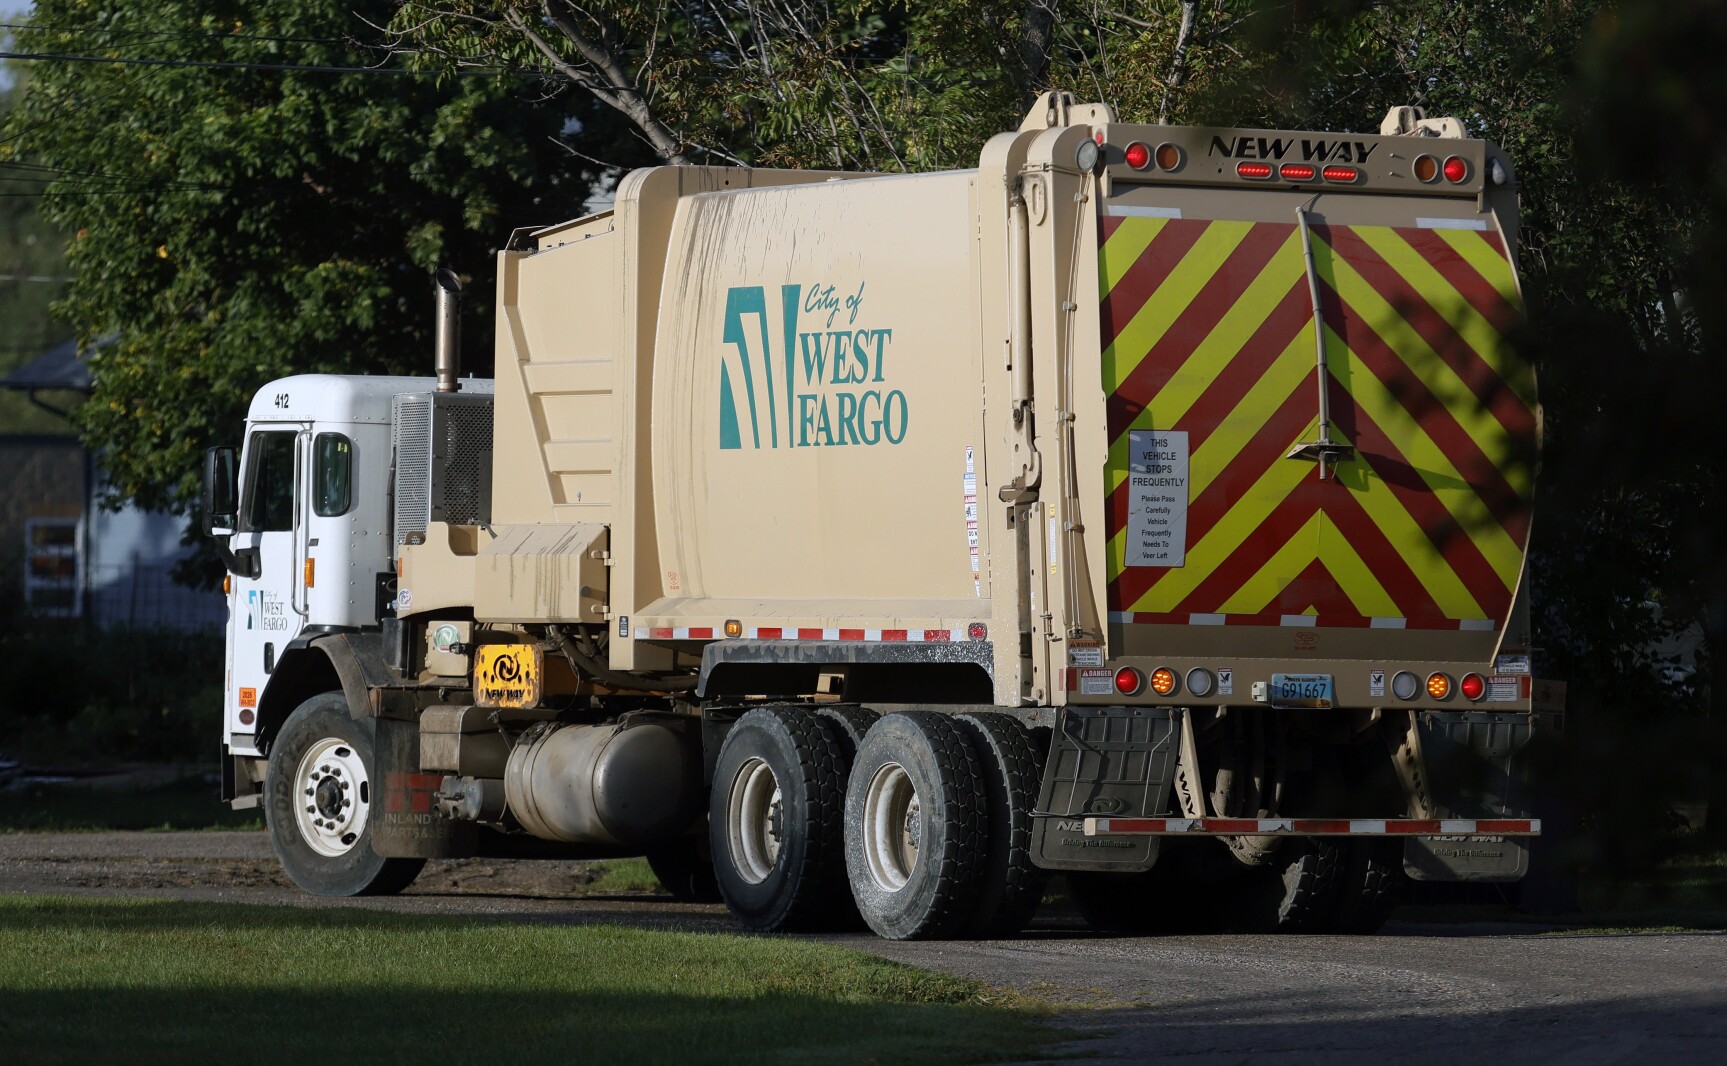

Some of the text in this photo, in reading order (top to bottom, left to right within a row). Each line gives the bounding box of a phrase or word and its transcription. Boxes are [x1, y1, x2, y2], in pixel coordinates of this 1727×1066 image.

[1208, 136, 1379, 163] NEW WAY
[805, 281, 865, 328] City of
[799, 329, 892, 386] WEST
[275, 393, 289, 408] 412
[797, 390, 909, 447] FARGO
[1150, 439, 1168, 447] THIS
[1143, 452, 1176, 460] VEHICLE
[1145, 465, 1172, 473] STOPS
[1132, 478, 1185, 487] FREQUENTLY
[1145, 507, 1171, 515] Carefully
[1141, 530, 1172, 538] Frequently
[264, 602, 284, 615] WEST
[263, 617, 288, 631] FARGO
[486, 689, 505, 699] NEW
[1282, 682, 1326, 699] G91667
[384, 813, 431, 824] INLAND
[1056, 820, 1085, 832] NE
